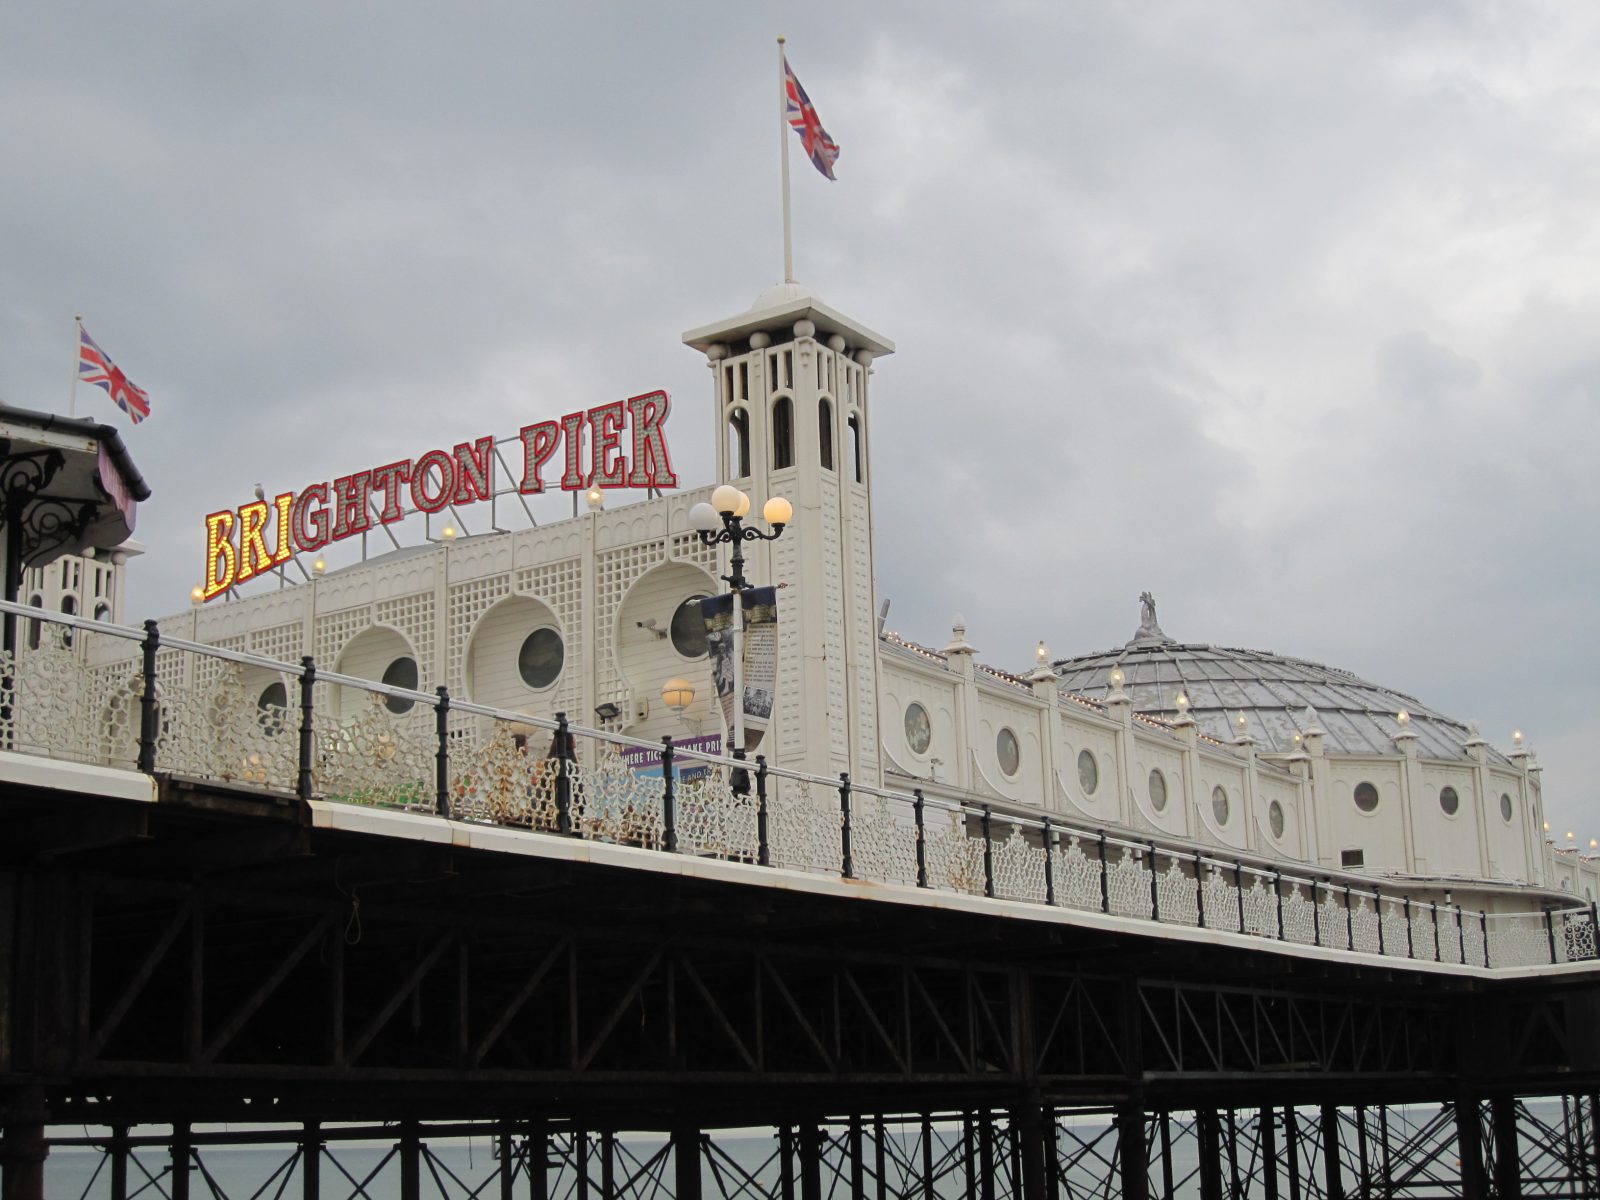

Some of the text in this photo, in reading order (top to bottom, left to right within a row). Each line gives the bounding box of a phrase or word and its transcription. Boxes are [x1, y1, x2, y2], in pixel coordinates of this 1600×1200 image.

[203, 389, 678, 601] BRIGHTON PIER
[705, 740, 721, 753] PRI
